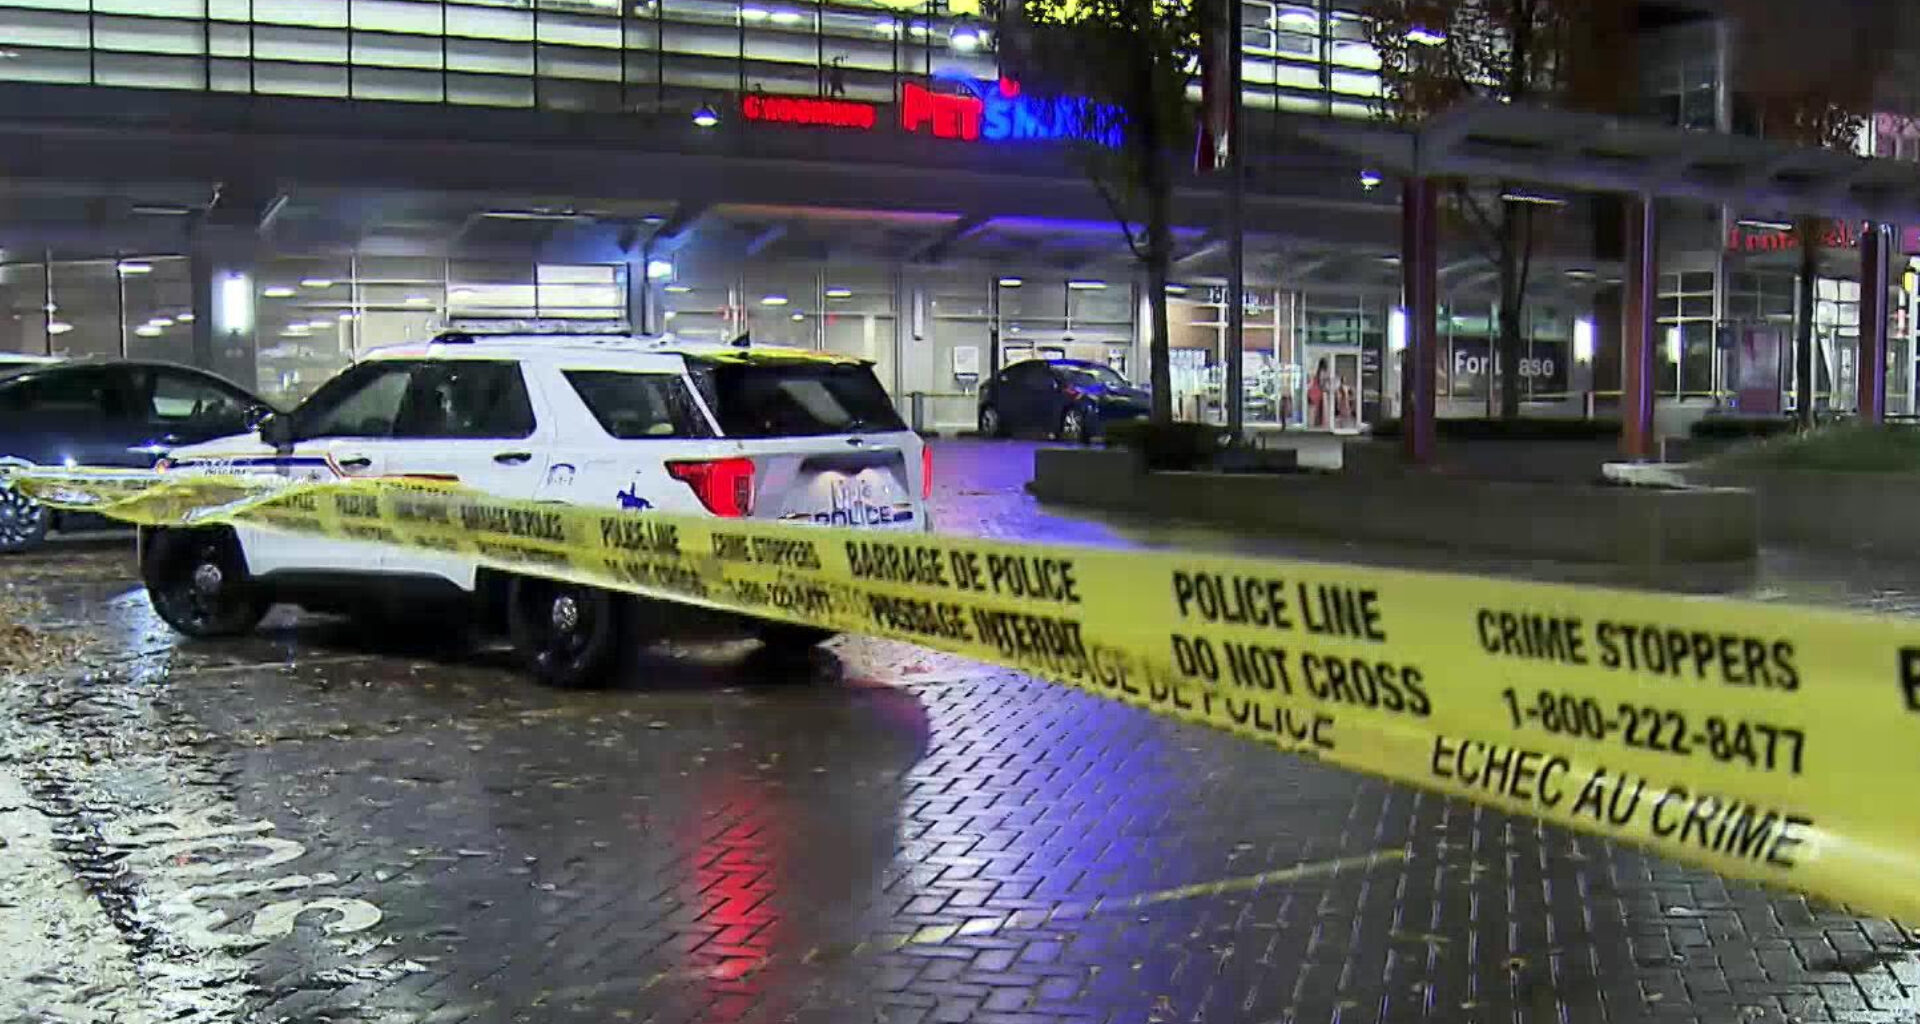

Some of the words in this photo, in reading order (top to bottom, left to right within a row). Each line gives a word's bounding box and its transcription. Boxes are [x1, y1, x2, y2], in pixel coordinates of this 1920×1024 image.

[1454, 350, 1488, 375] For
[600, 516, 649, 550] POLICE
[845, 540, 949, 588] BARRAGE
[950, 550, 986, 593] DE
[985, 554, 1082, 604] POLICE
[1171, 570, 1294, 630] POLICE
[1297, 581, 1387, 644] LINE
[1171, 632, 1221, 684] DO
[1222, 640, 1293, 696] NOT
[1300, 651, 1432, 718] CROSS
[1475, 606, 1590, 667] CRIME
[1596, 621, 1802, 692] STOPPERS
[1502, 687, 1807, 775] 1-800-222-8477
[1430, 734, 1571, 807] ECHEC
[1573, 767, 1648, 826] AU
[1650, 788, 1814, 869] CRIME
